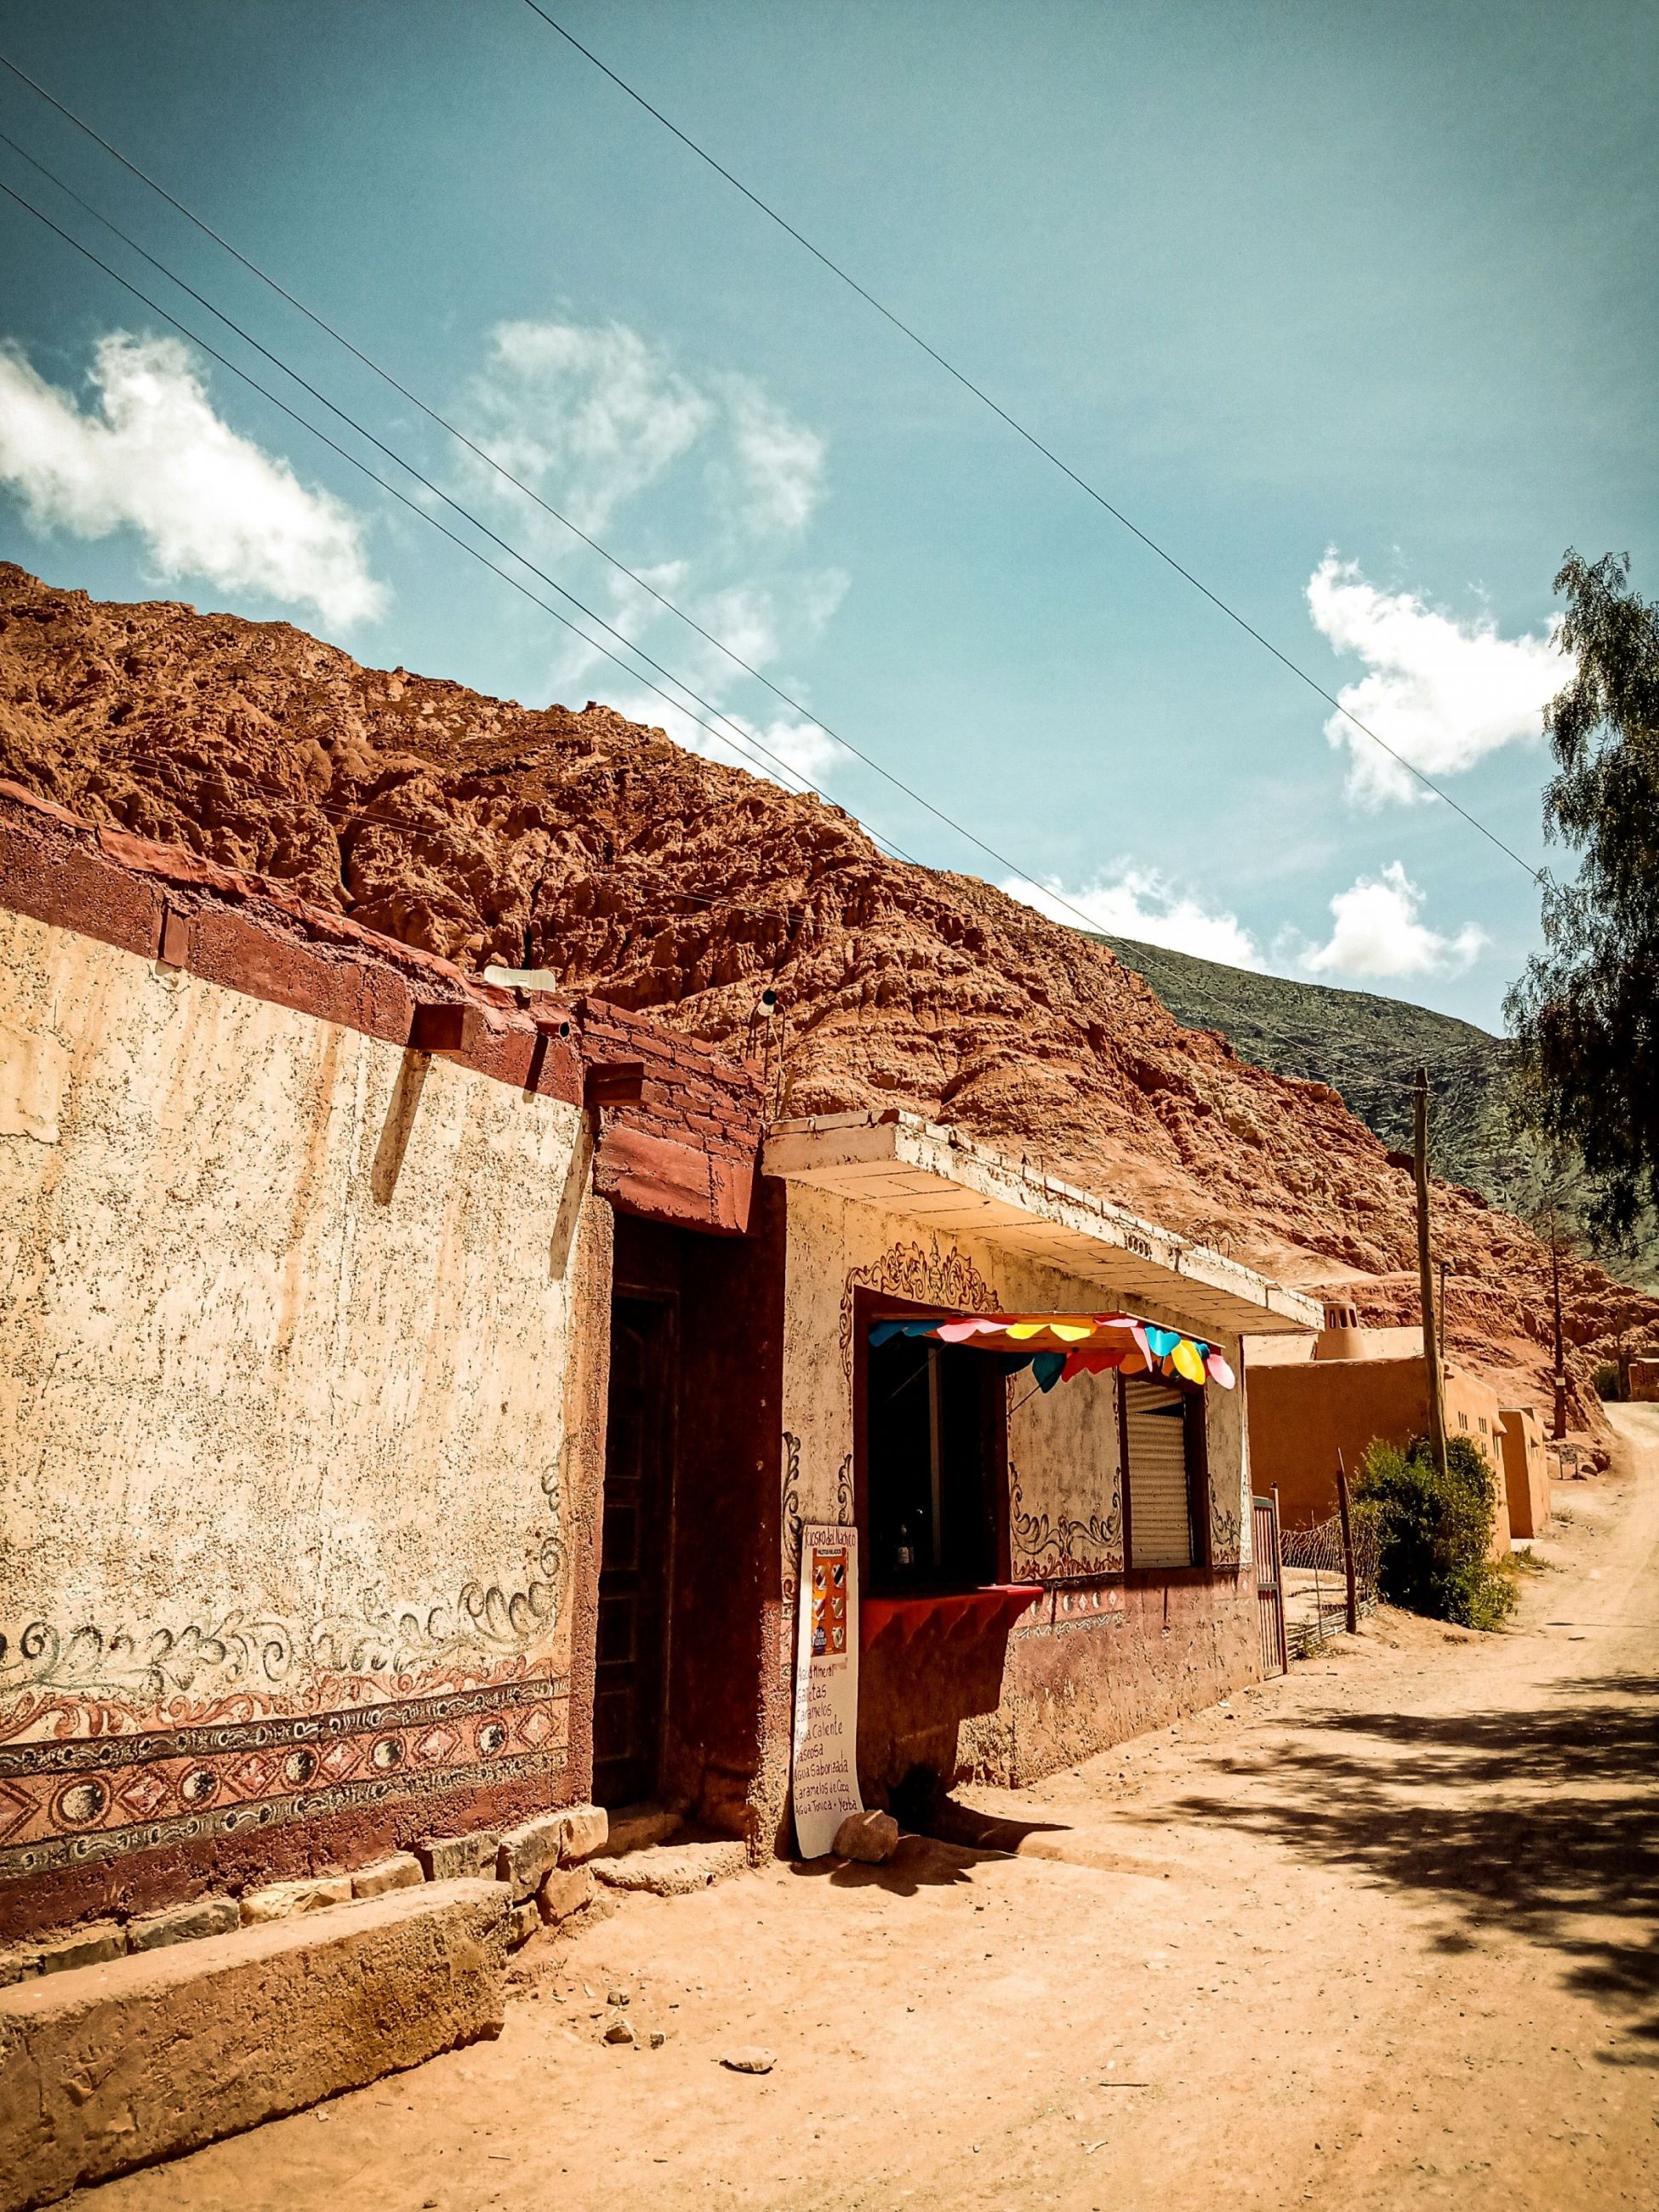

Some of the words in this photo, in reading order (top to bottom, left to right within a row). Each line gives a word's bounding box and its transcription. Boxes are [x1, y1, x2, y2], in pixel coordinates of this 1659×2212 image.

[826, 1527, 835, 1546] del
[796, 1702, 832, 1722] Caramelos
[812, 1714, 843, 1738] Caliente
[810, 1749, 849, 1777] Saborizada
[794, 1781, 829, 1800] Caramelos
[830, 1781, 836, 1793] de
[838, 1796, 858, 1813] Yerba
